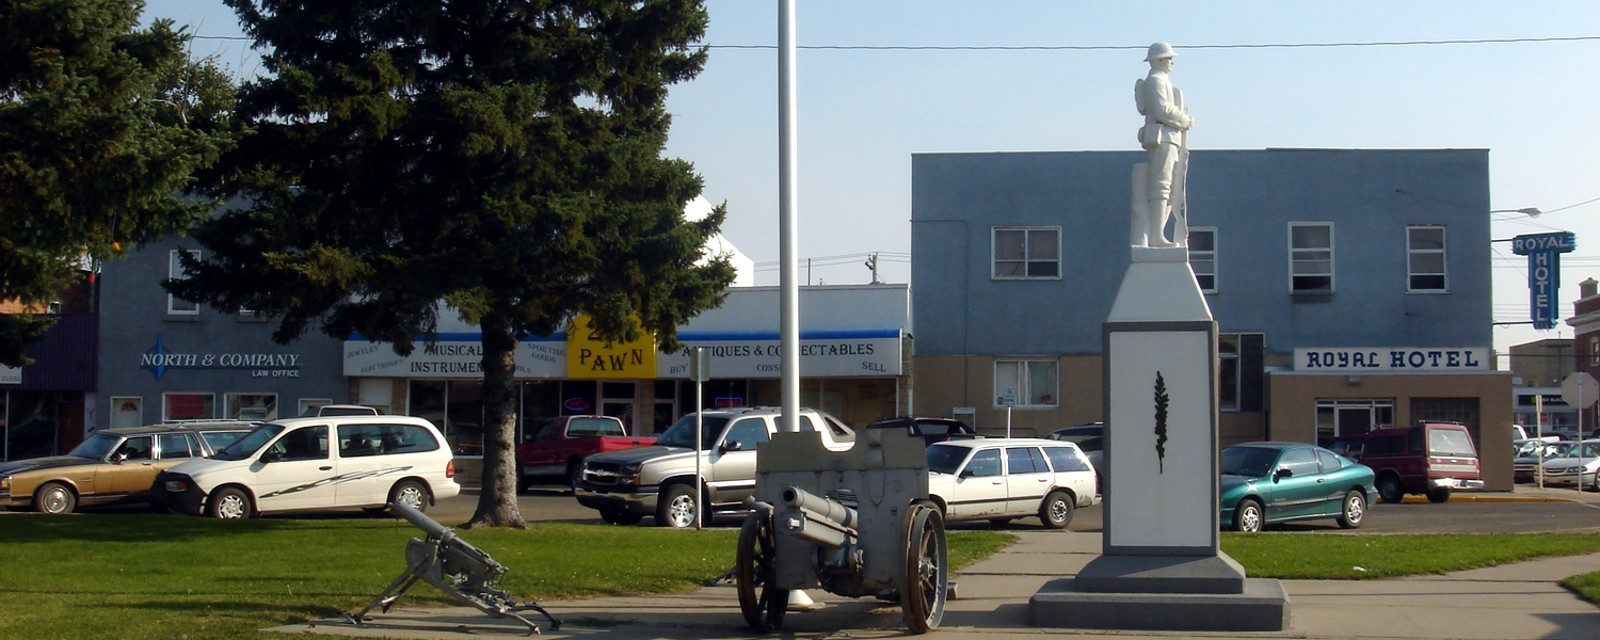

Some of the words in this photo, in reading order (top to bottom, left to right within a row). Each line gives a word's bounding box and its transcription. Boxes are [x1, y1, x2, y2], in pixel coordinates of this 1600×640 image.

[1515, 236, 1568, 251] ROYAL
[1535, 253, 1548, 322] HOTEL
[428, 344, 484, 356] MUSICAL
[682, 345, 750, 358] AIQUES
[754, 345, 764, 356] &
[767, 344, 874, 357] COECTABLES
[140, 353, 197, 367] NORTH
[202, 354, 215, 367] &
[219, 353, 299, 367] COMPANY
[531, 352, 557, 363] GOODS
[579, 349, 643, 371] PAWN
[1307, 351, 1380, 368] ROYAL
[1390, 351, 1478, 368] HOTEL
[410, 361, 485, 373] INSTRUMEN
[670, 362, 688, 374] BUY
[862, 361, 886, 372] SELL
[252, 369, 269, 378] LAW
[272, 369, 300, 378] OFFICE
